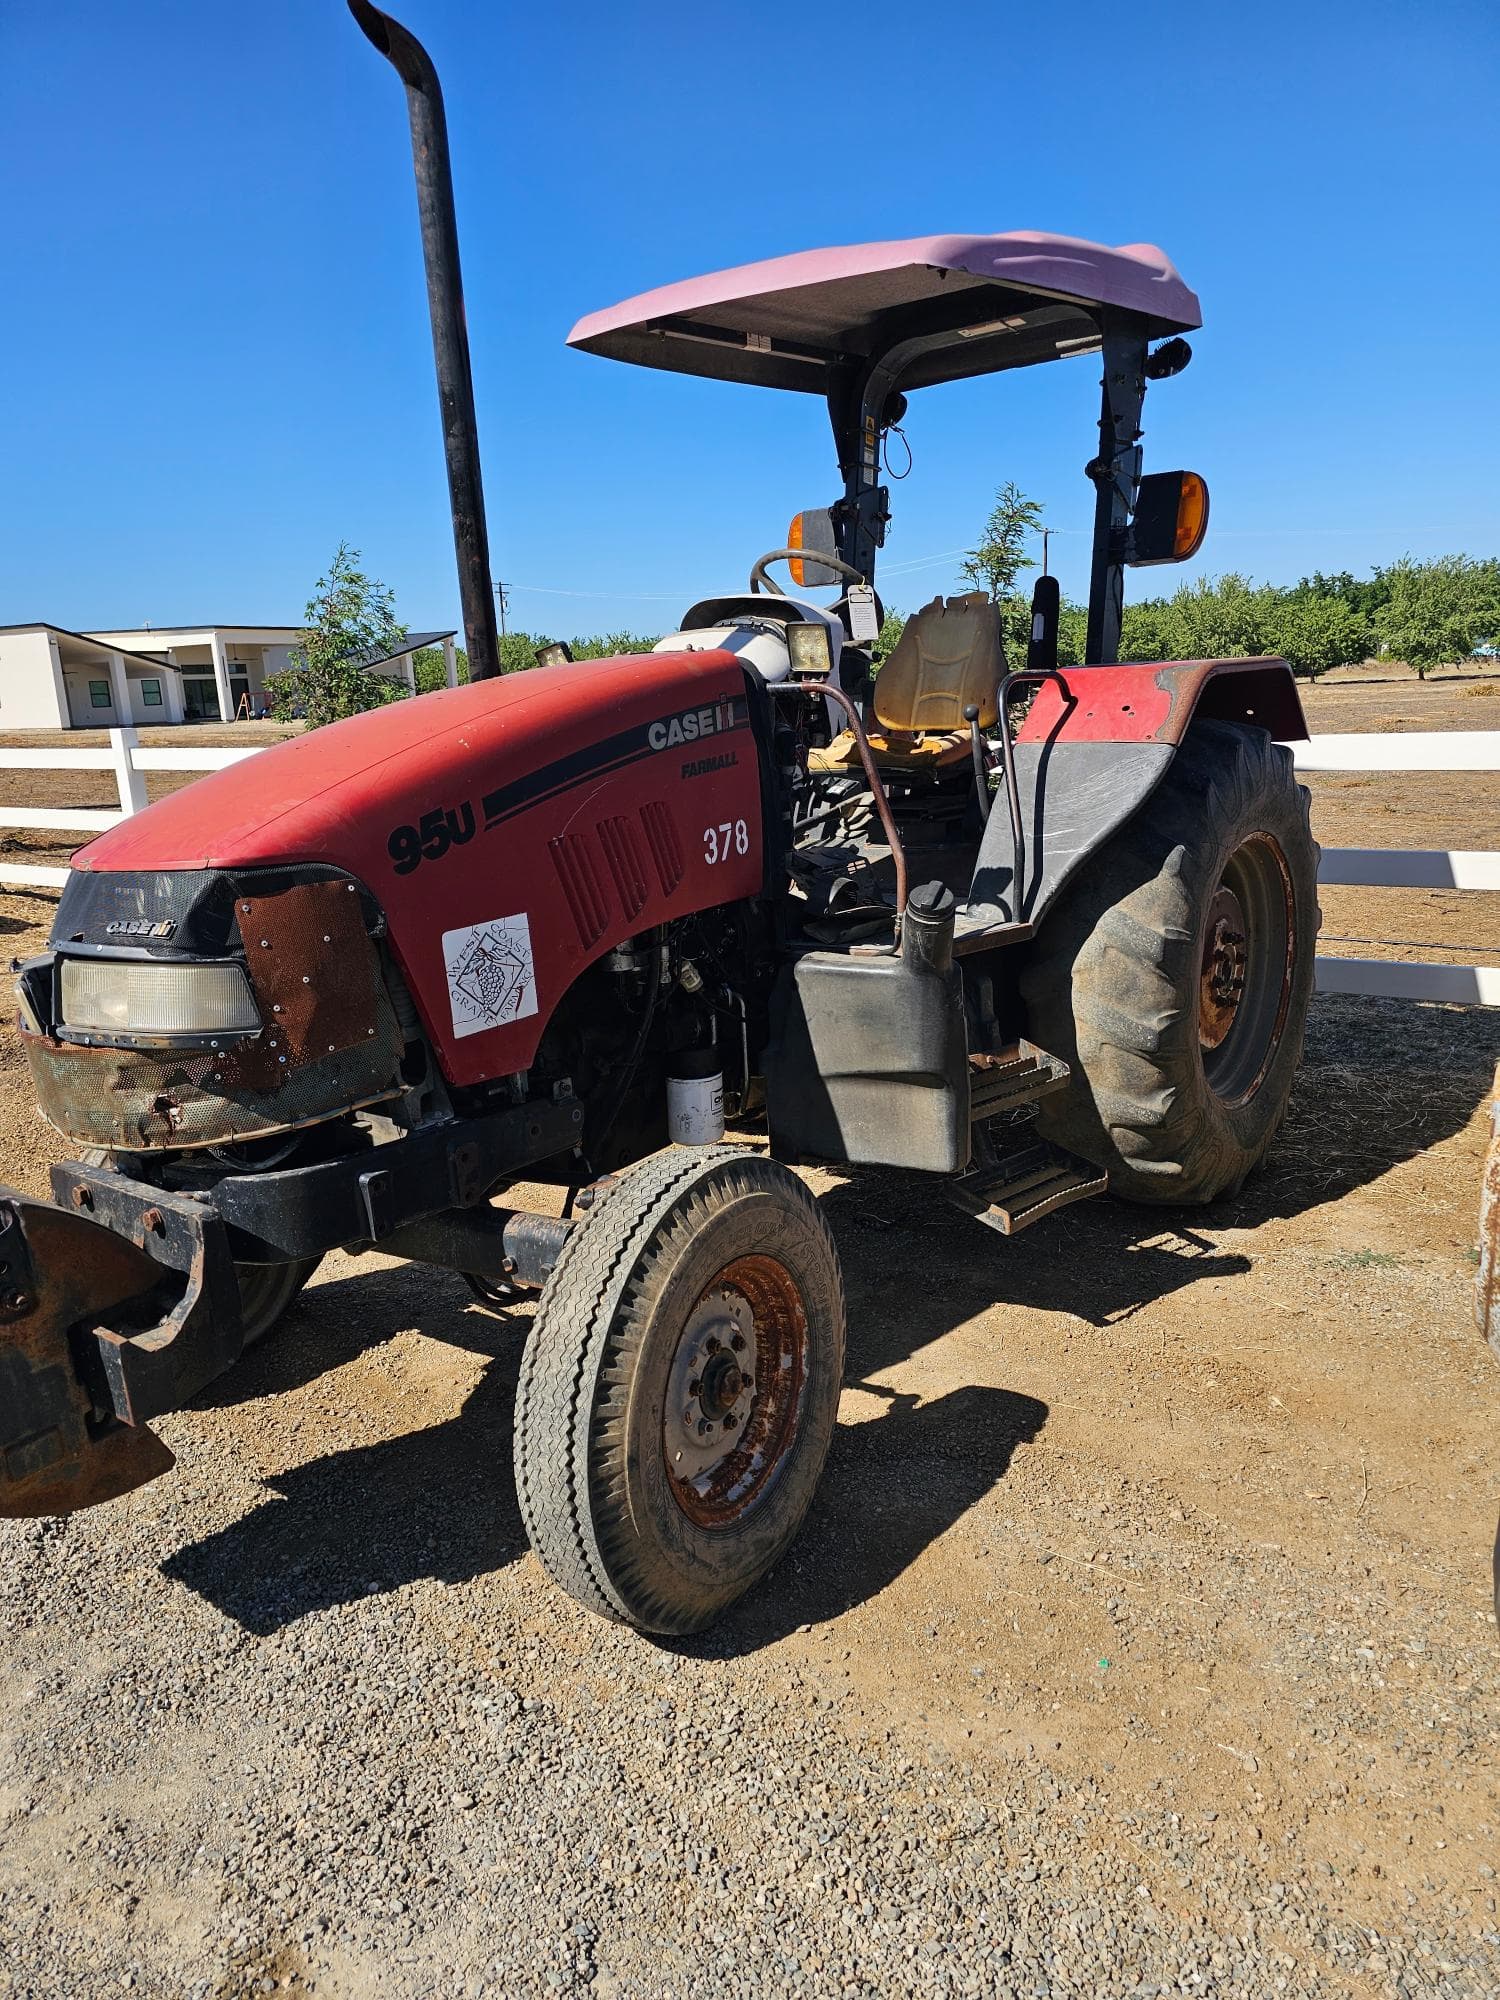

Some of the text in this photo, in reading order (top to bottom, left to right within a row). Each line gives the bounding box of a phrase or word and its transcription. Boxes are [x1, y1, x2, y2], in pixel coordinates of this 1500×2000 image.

[681, 752, 738, 779] FARMALL
[388, 800, 476, 875] 95U
[703, 819, 749, 865] 378
[447, 923, 530, 978] WEST COAST
[451, 990, 494, 1027] GRAPE
